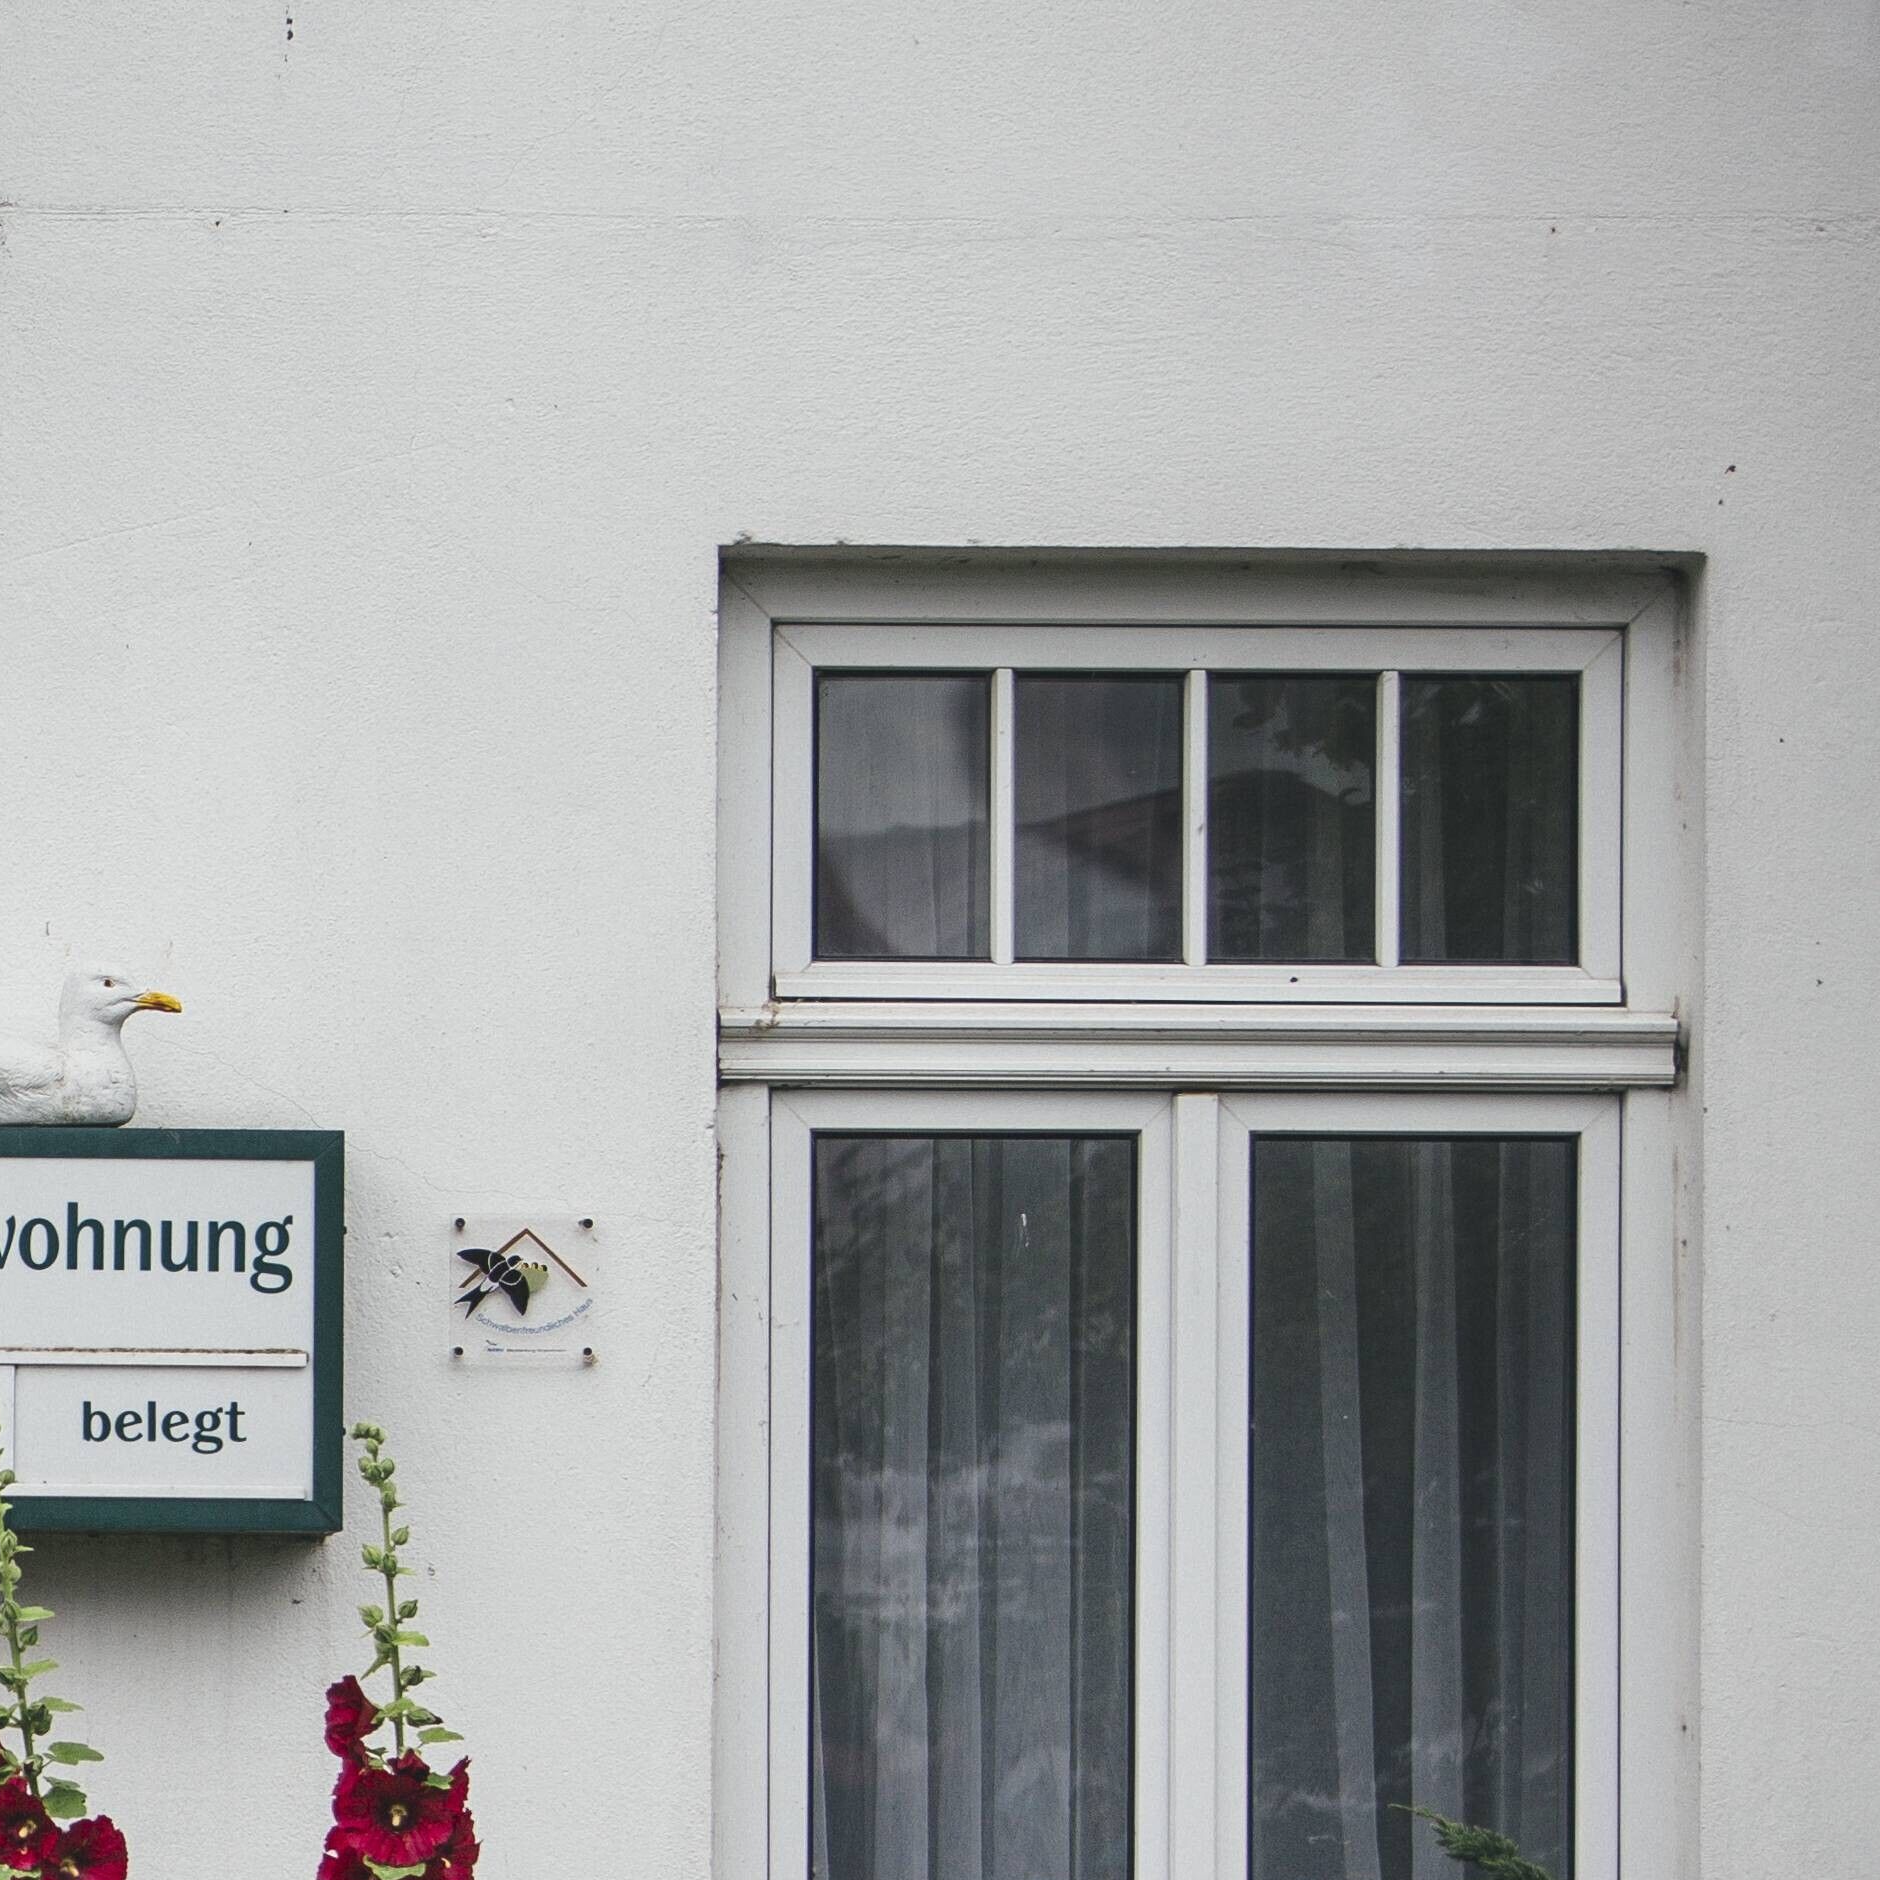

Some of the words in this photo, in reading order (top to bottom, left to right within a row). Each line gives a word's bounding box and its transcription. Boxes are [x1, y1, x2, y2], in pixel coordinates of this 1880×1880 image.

[476, 1313, 574, 1334] Schwalbenfreundliches
[574, 1298, 593, 1316] Haus
[83, 1401, 246, 1454] belegt
